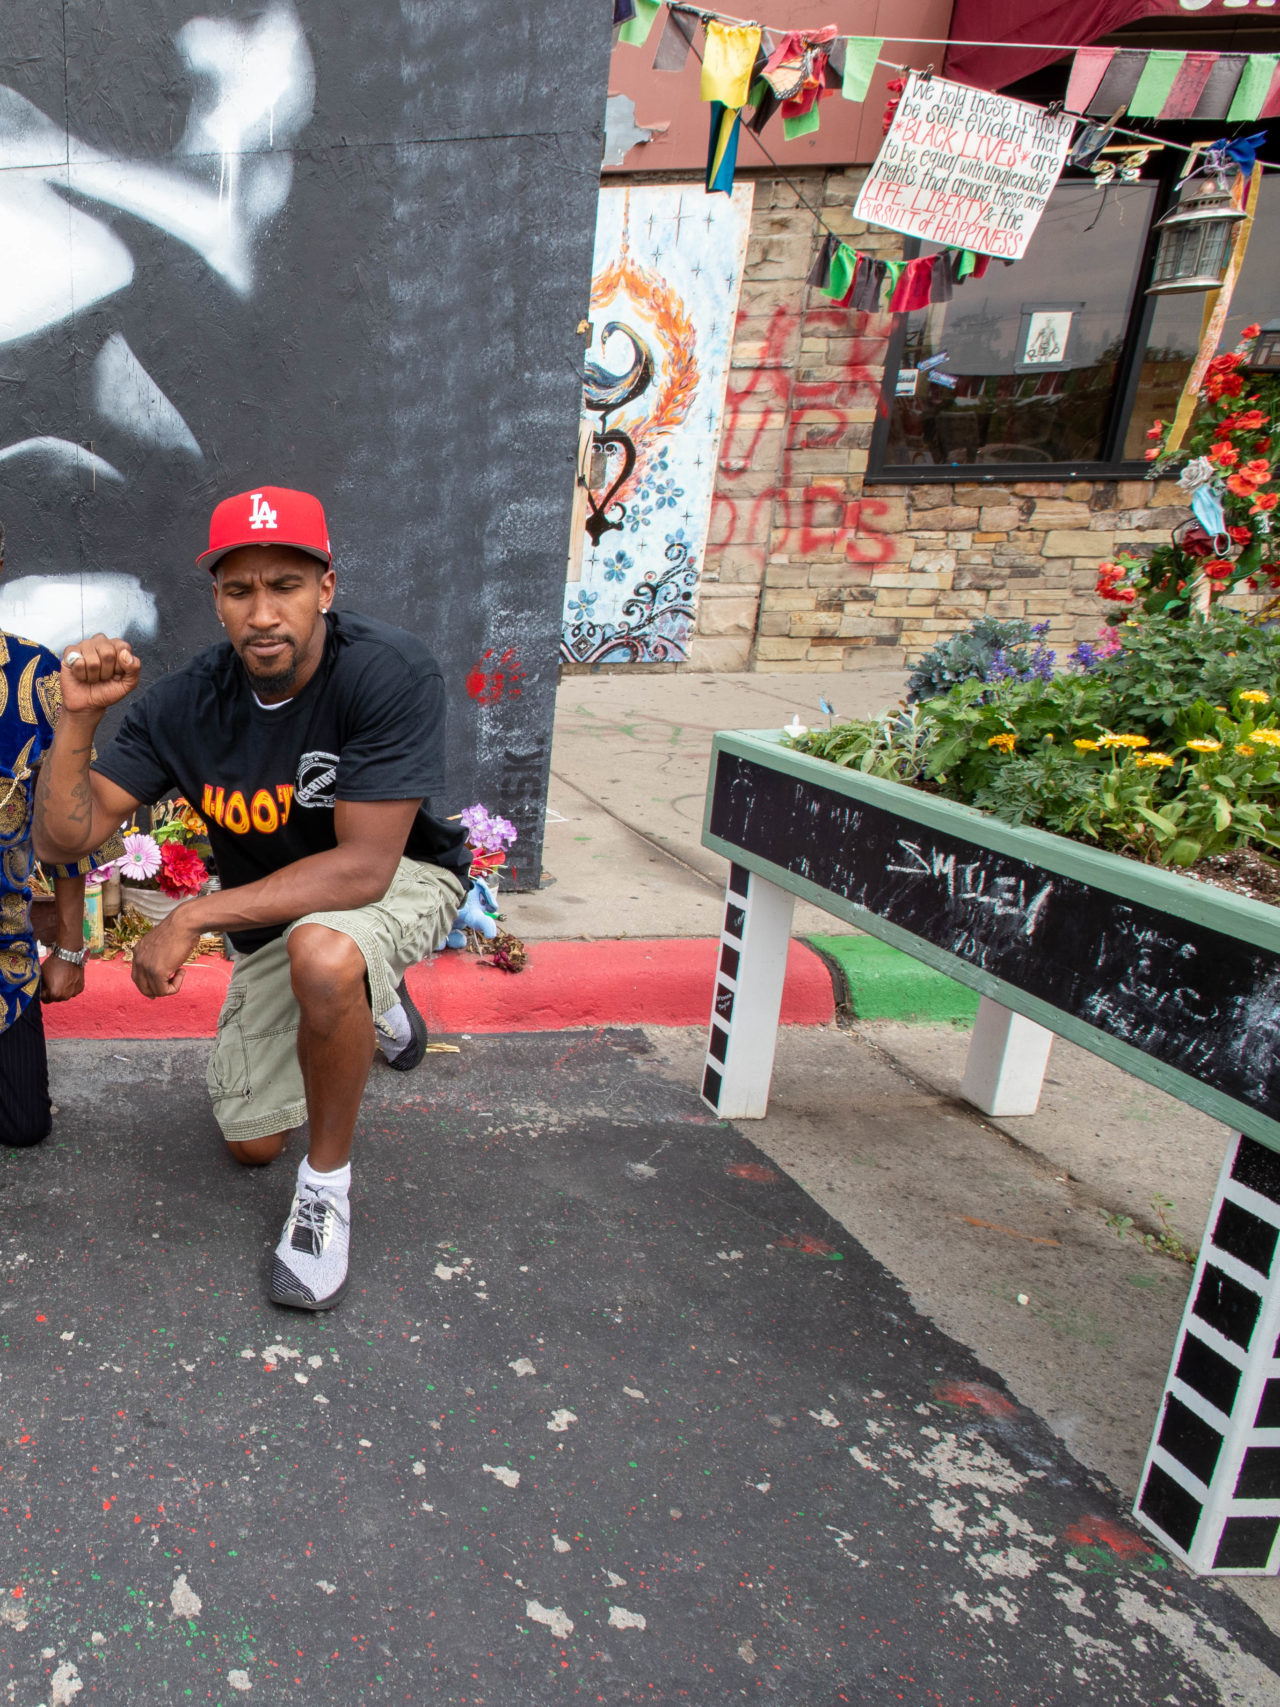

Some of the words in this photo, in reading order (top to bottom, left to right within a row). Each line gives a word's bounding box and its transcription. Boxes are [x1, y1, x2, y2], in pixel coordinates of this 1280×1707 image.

[902, 98, 920, 118] be
[926, 104, 1027, 143] self-evident
[1032, 131, 1061, 154] that
[941, 82, 966, 106] hold
[971, 90, 1011, 118] these
[1060, 113, 1072, 137] to
[883, 139, 898, 158] to
[901, 142, 916, 163] be
[920, 150, 961, 175] equal
[960, 158, 984, 180] with
[1031, 153, 1059, 174] are
[920, 168, 951, 192] that
[992, 184, 1024, 208] these
[1024, 196, 1046, 212] are
[932, 217, 1023, 257] HAPPINESS
[997, 207, 1024, 230] the
[249, 493, 277, 529] LA
